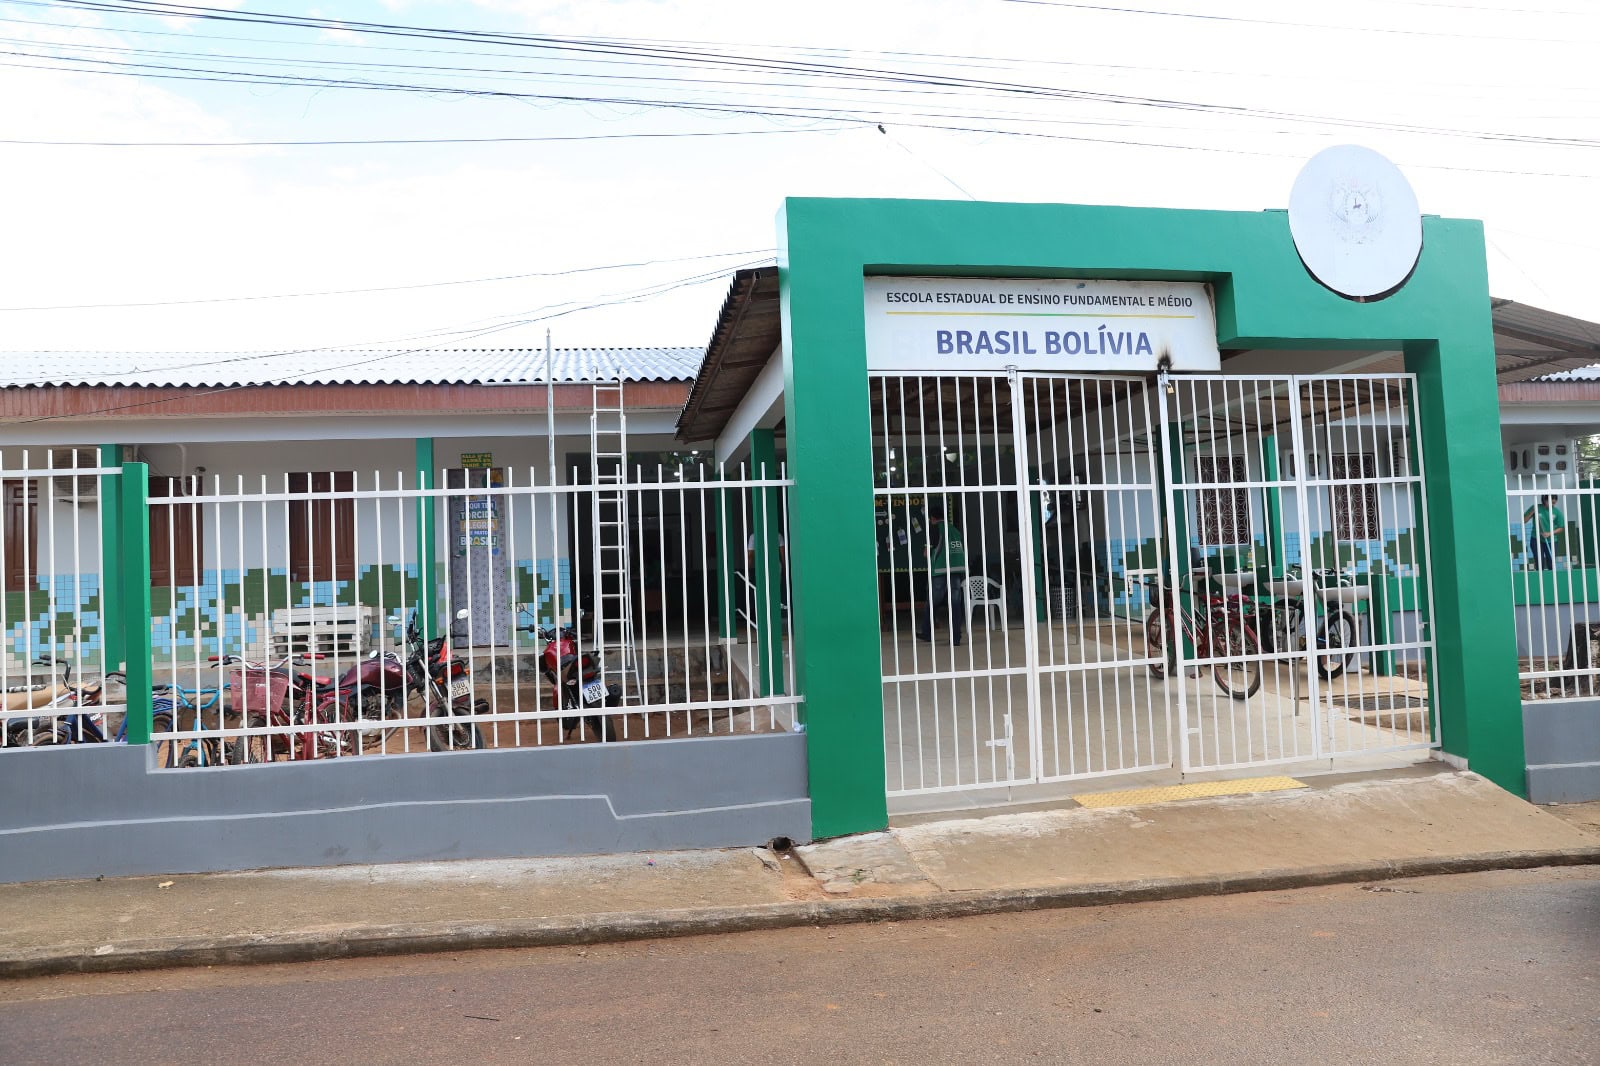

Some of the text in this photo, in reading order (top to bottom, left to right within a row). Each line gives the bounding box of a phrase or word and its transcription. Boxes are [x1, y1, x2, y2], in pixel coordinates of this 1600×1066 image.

[886, 292, 1193, 308] ESCOLA ESTADUAL DE ENSINO FUNDAMENTAL E MÉDIO
[936, 324, 1154, 355] BRASIL BOLÍVIA
[463, 520, 495, 529] LEGRA
[460, 536, 497, 546] BRASI!
